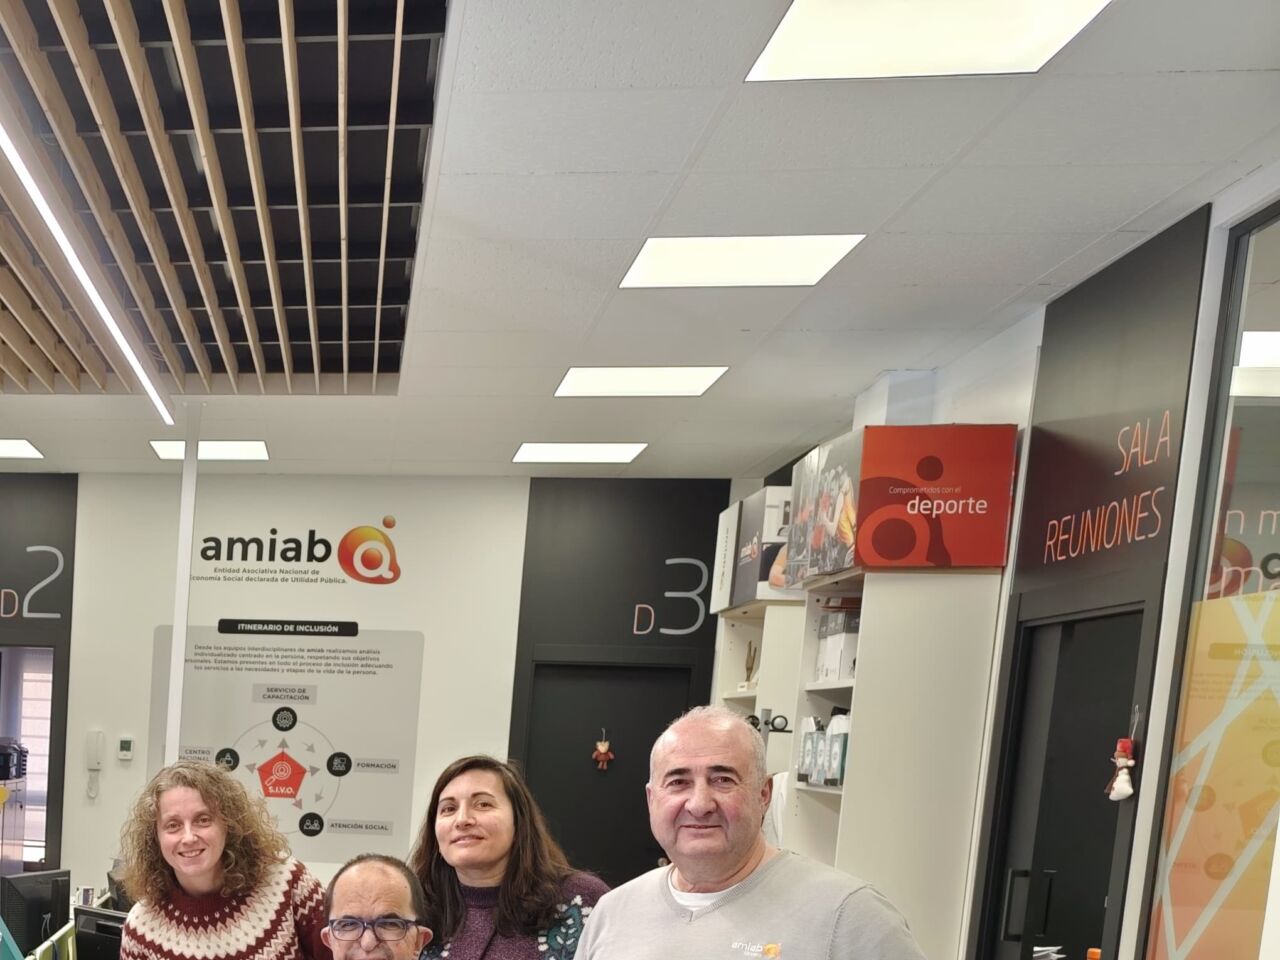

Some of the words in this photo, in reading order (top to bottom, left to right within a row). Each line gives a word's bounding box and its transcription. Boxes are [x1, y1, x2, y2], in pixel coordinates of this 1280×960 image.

[1114, 410, 1172, 476] SALA
[888, 486, 940, 494] Comprometidos
[907, 495, 987, 519] deporte
[1044, 486, 1166, 564] REUNIONES
[200, 528, 332, 563] amiab
[214, 566, 240, 574] Entidad
[242, 566, 277, 575] Asociativa
[279, 567, 309, 576] Nacional
[310, 568, 320, 576] de
[223, 574, 243, 583] Social
[245, 575, 279, 583] declarada
[280, 575, 289, 583] de
[290, 575, 318, 584] Utilidad
[238, 623, 282, 632] ITINERARIO
[284, 624, 294, 632] DE
[296, 624, 339, 633] INCLUSIÓN
[262, 693, 310, 701] CAPACITACIÓN
[356, 761, 396, 770] FORMACIÓN
[268, 785, 294, 795] S.I.V.O.
[330, 821, 362, 830] ATENCIÓN
[364, 823, 388, 831] SOCIAL
[731, 941, 763, 952] amiab
